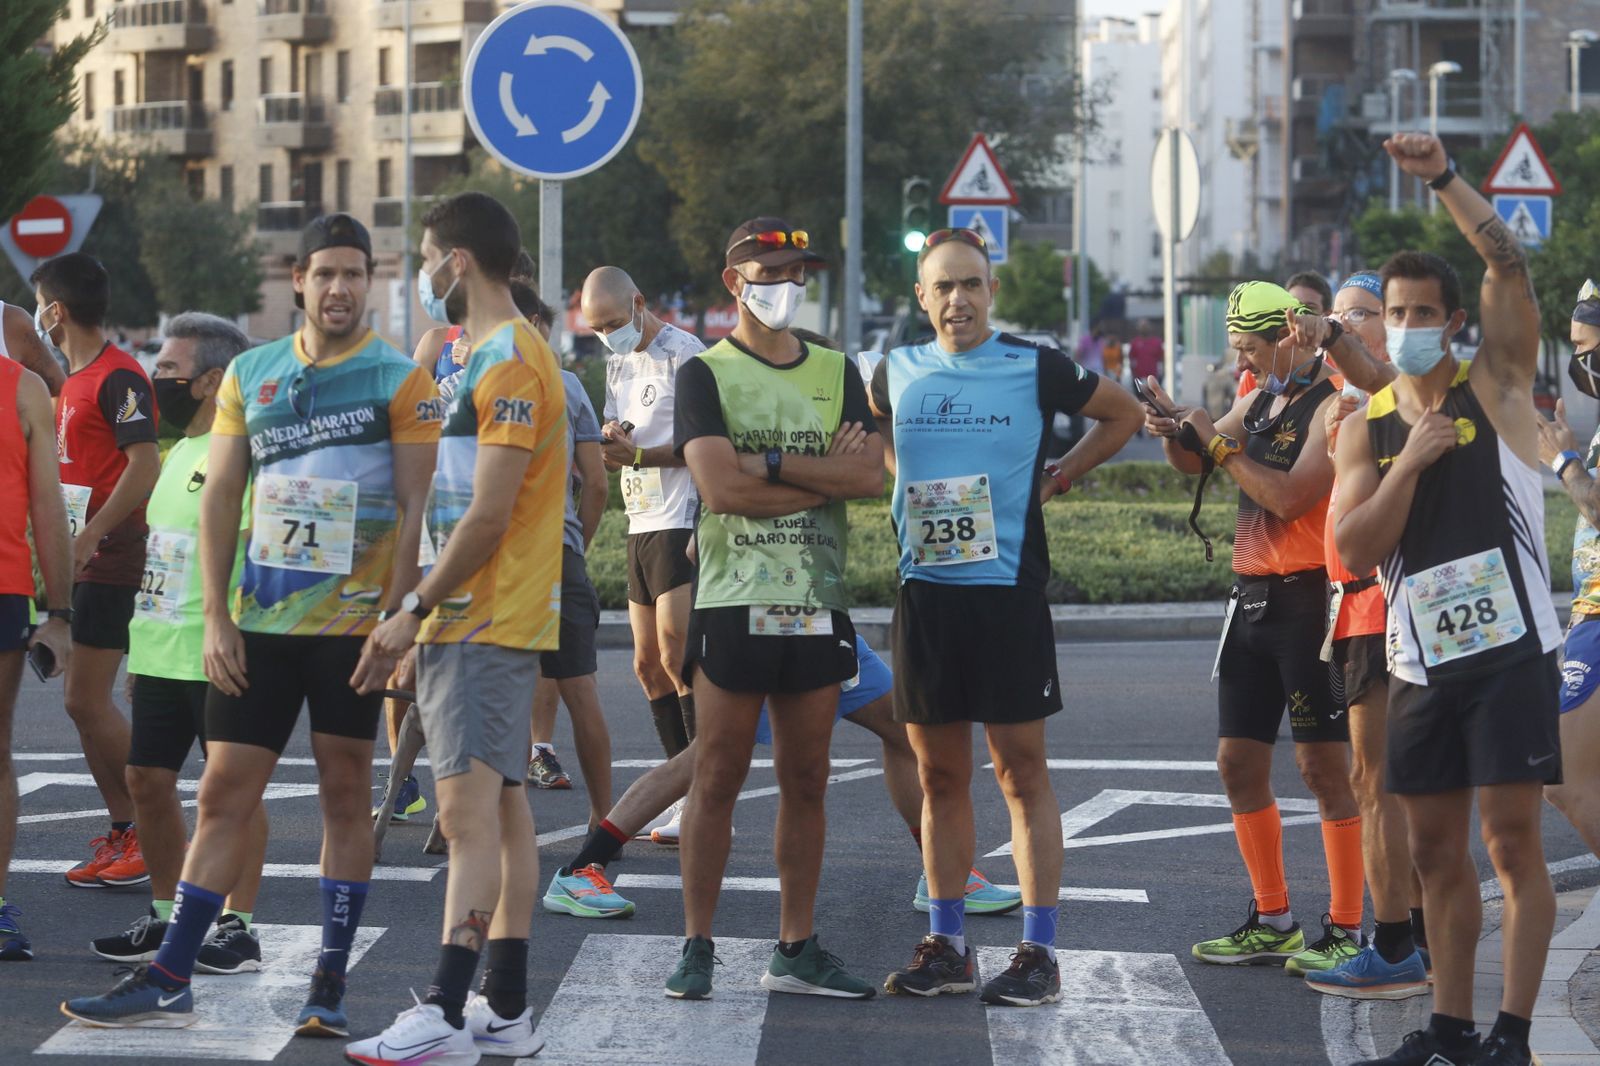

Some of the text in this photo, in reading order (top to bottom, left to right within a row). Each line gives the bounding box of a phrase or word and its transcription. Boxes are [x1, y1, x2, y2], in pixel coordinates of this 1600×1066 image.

[494, 398, 533, 426] 21K
[264, 424, 309, 444] MEDIA
[733, 429, 787, 444] MARATÓN
[790, 431, 822, 443] OPEN
[283, 519, 319, 548] 71
[734, 532, 786, 546] CLARO
[789, 532, 815, 545] QUE
[922, 516, 976, 545] 238
[1436, 597, 1498, 636] 428
[332, 883, 350, 927] PAST
